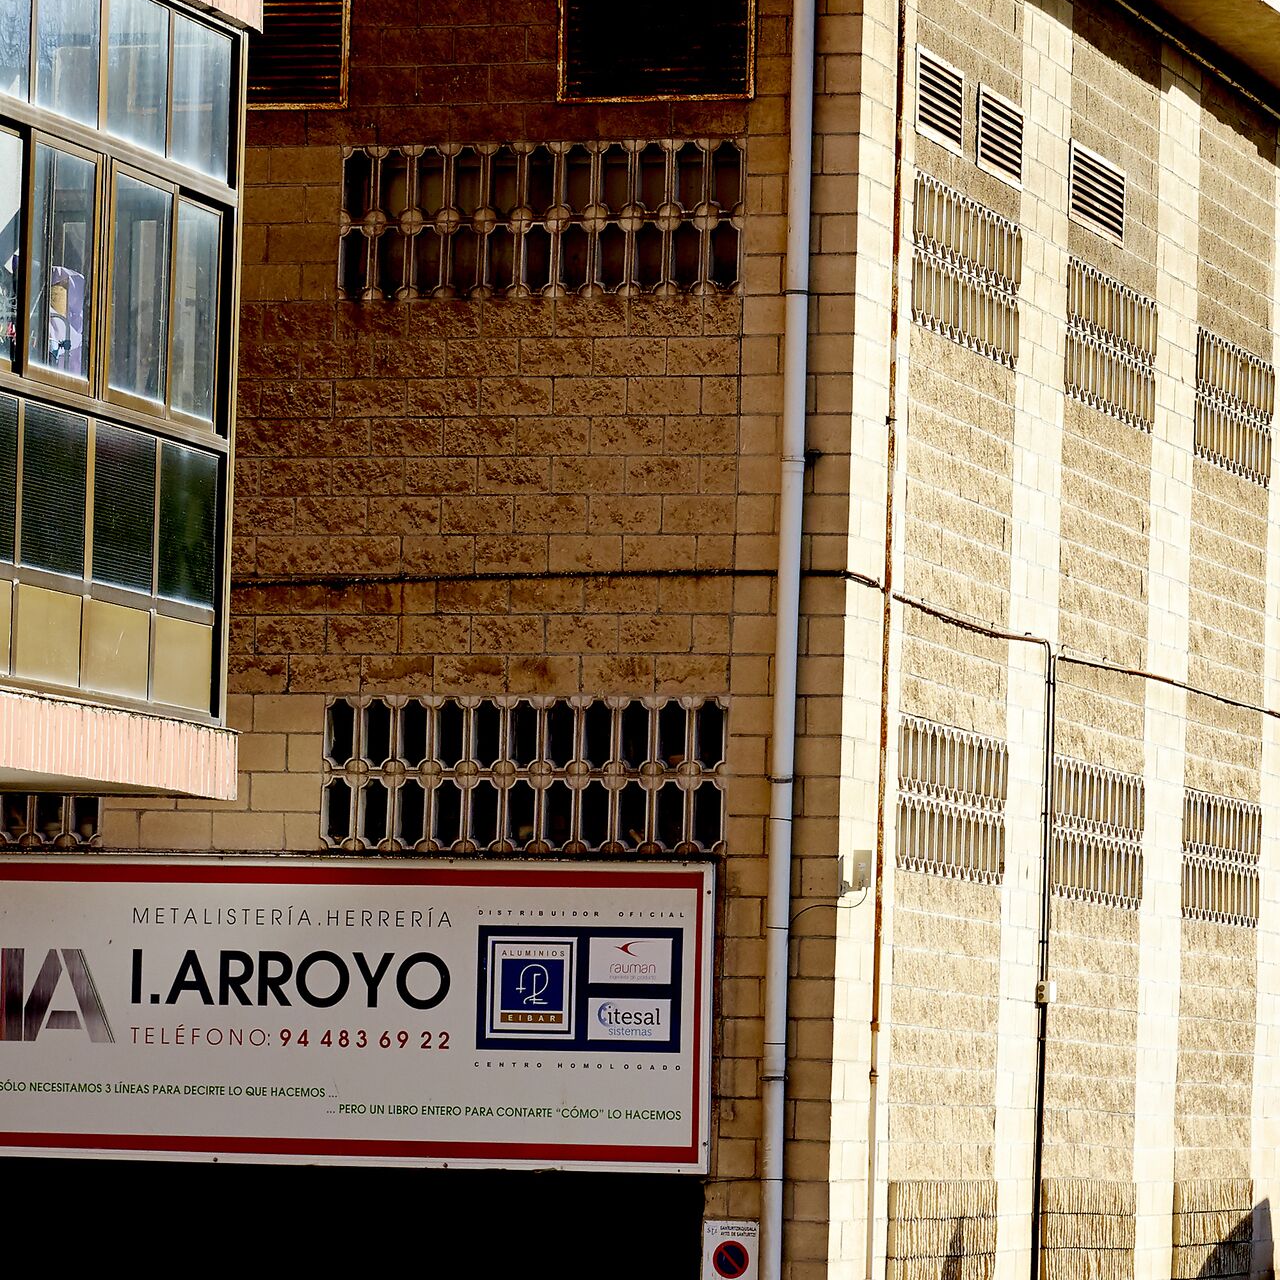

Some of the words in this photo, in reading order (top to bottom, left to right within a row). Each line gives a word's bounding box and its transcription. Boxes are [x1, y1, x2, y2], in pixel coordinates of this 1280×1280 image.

[478, 909, 600, 917] DISTRIBUIDOR
[501, 949, 565, 958] ALUMINIOS
[609, 962, 656, 974] rauman
[131, 948, 451, 1010] I.ARROYO
[508, 1014, 557, 1022] EIBAR
[131, 1023, 271, 1047] TELÉFONO:
[280, 1028, 309, 1048] 94
[320, 1029, 368, 1049] 483
[379, 1030, 410, 1050] 69
[420, 1031, 451, 1051] 22
[608, 1027, 653, 1037] sistemas
[557, 1063, 681, 1071] HOMOLOGADO
[29, 1081, 102, 1093] NECESITAMOS
[105, 1082, 111, 1093] 3
[114, 1080, 150, 1094] LÍNEAS
[152, 1084, 181, 1095] PARA
[184, 1085, 225, 1096] DECIRTE
[228, 1086, 243, 1096] LO
[245, 1086, 267, 1097] QUE
[270, 1087, 326, 1098] HACEMOS
[339, 1104, 367, 1115] PERO
[369, 1104, 385, 1115] UN
[388, 1104, 418, 1116] LIBRO
[421, 1105, 462, 1117] ENTERO
[465, 1106, 494, 1117] PARA
[496, 1106, 552, 1118] CONTARTE
[608, 1109, 622, 1119] LO
[625, 1109, 682, 1120] HACEMOS
